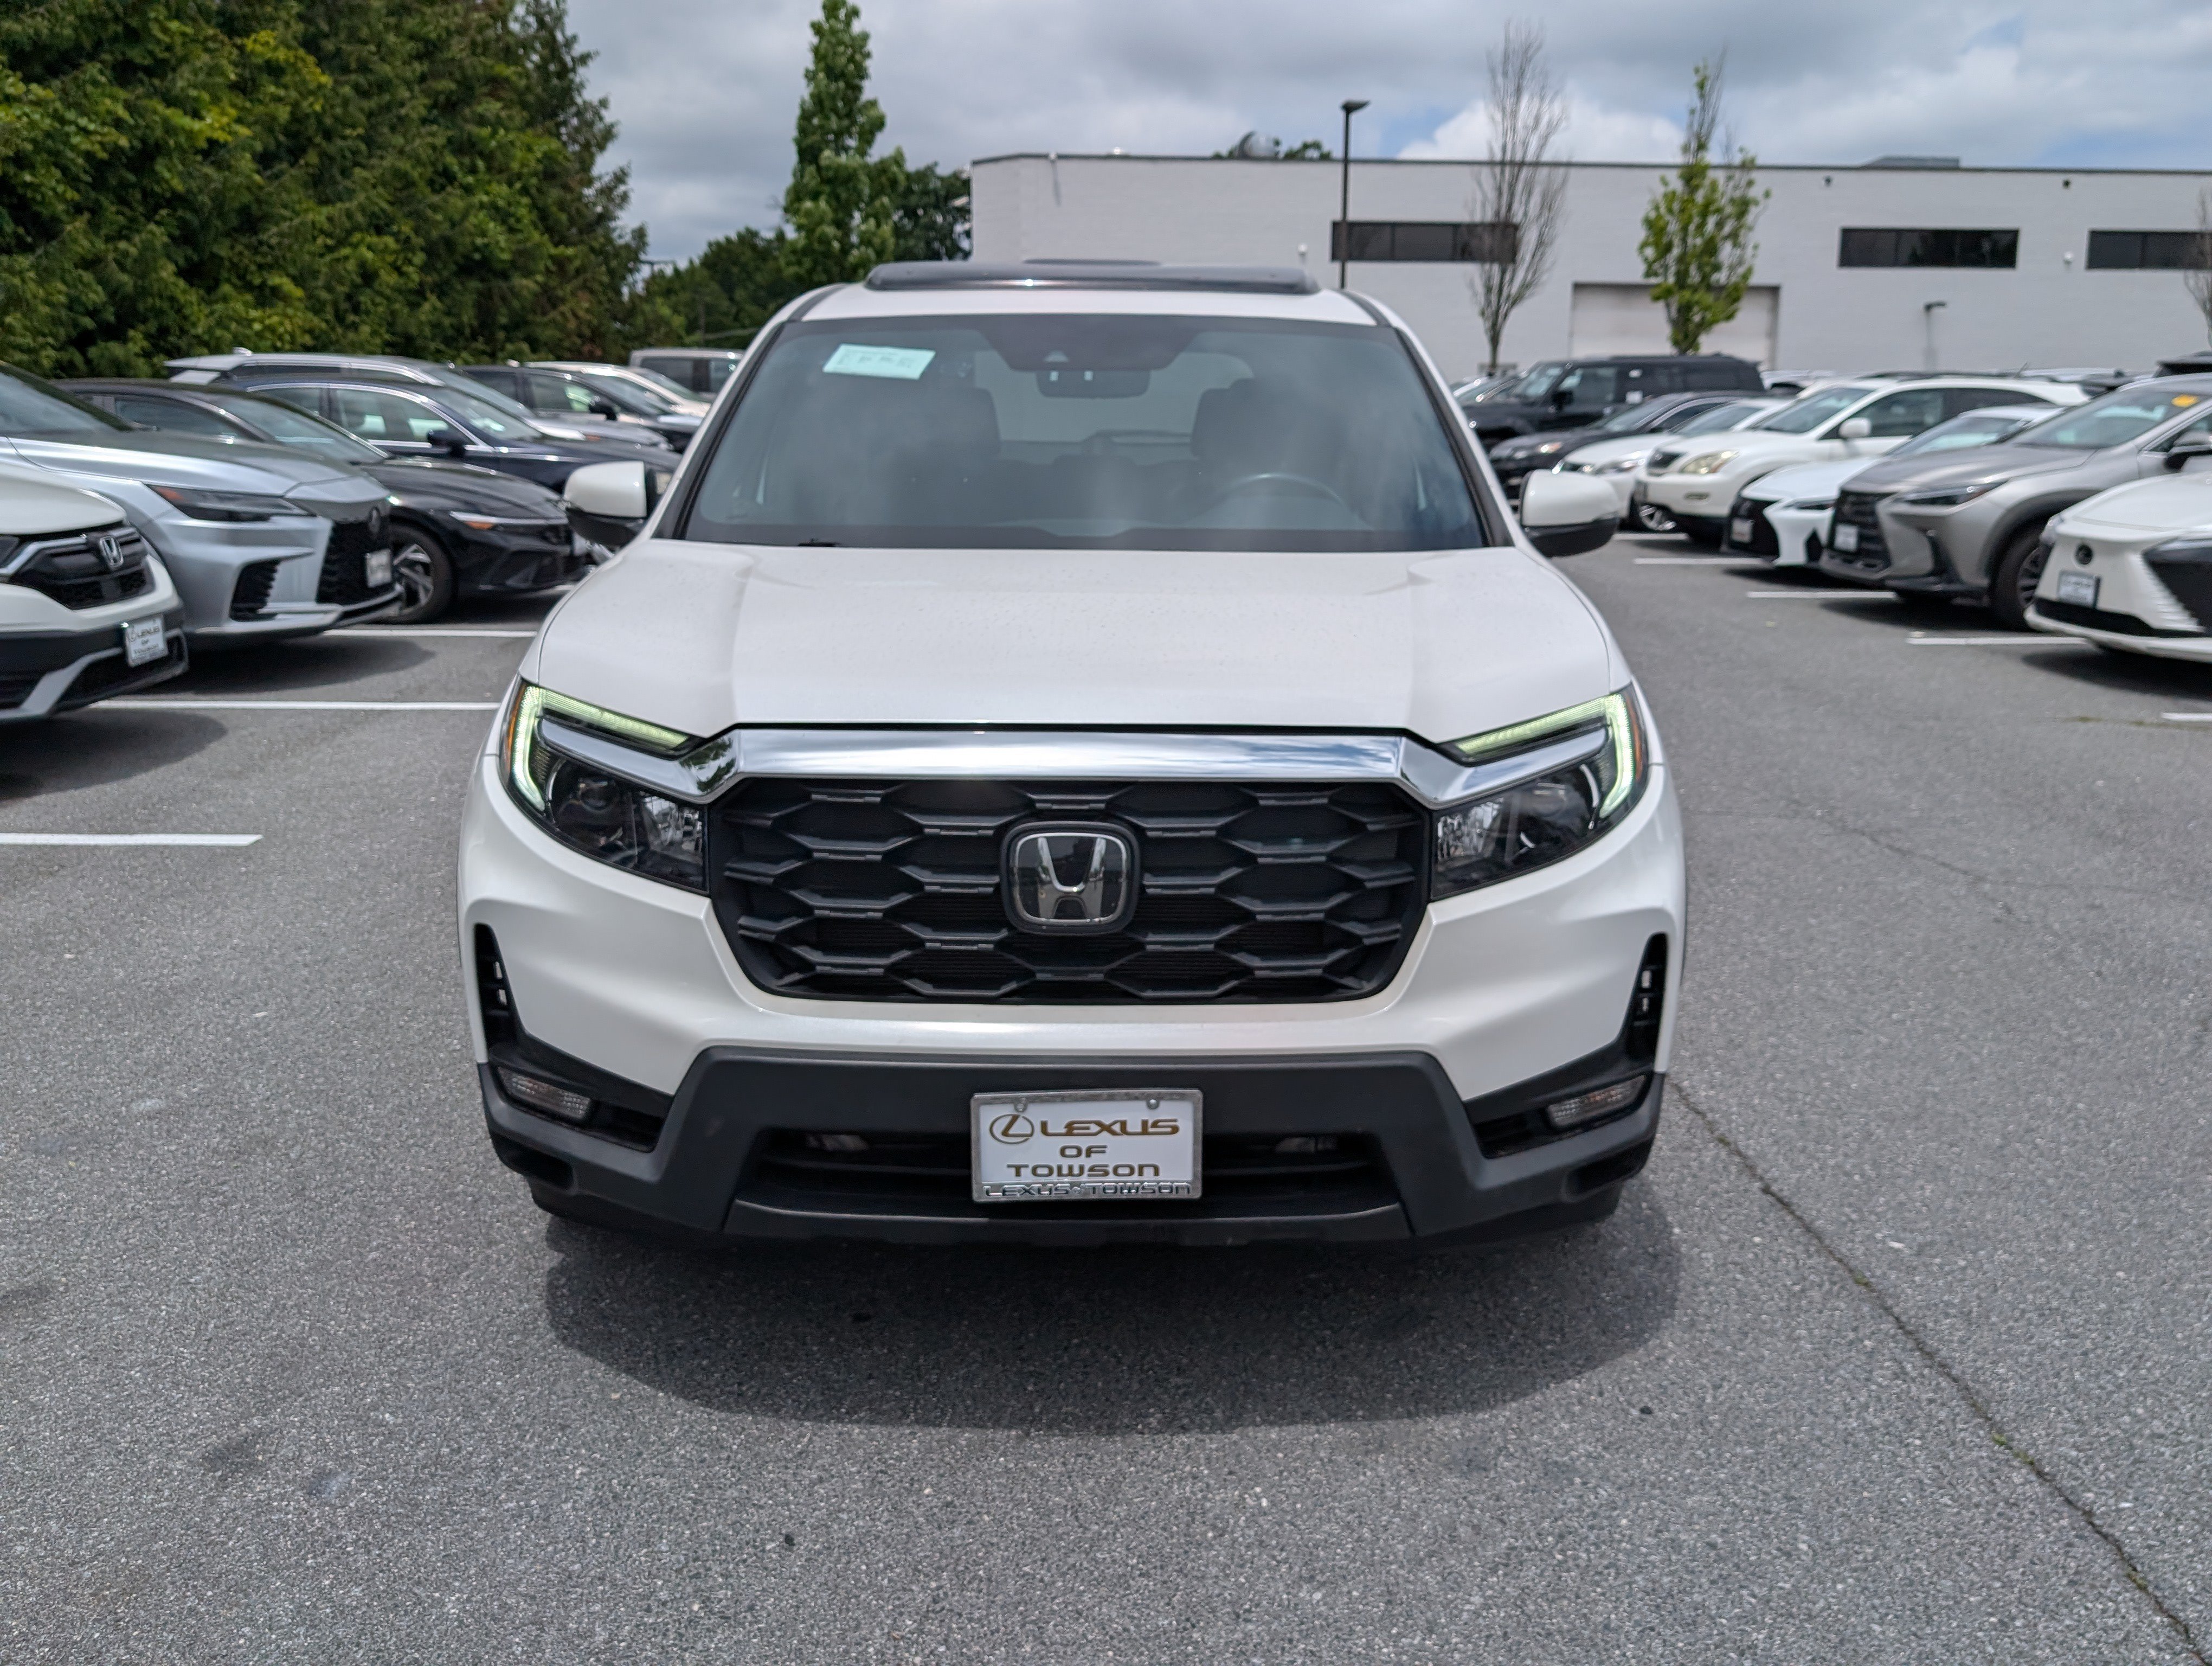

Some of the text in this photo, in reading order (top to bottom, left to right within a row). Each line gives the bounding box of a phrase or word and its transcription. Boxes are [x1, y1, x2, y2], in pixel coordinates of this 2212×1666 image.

[1040, 1118, 1180, 1136] LEXUS
[1059, 1144, 1108, 1158] OF
[1006, 1163, 1160, 1177] TOWSON
[982, 1183, 1072, 1197] LEXUS
[1084, 1182, 1190, 1194] TOWSON
